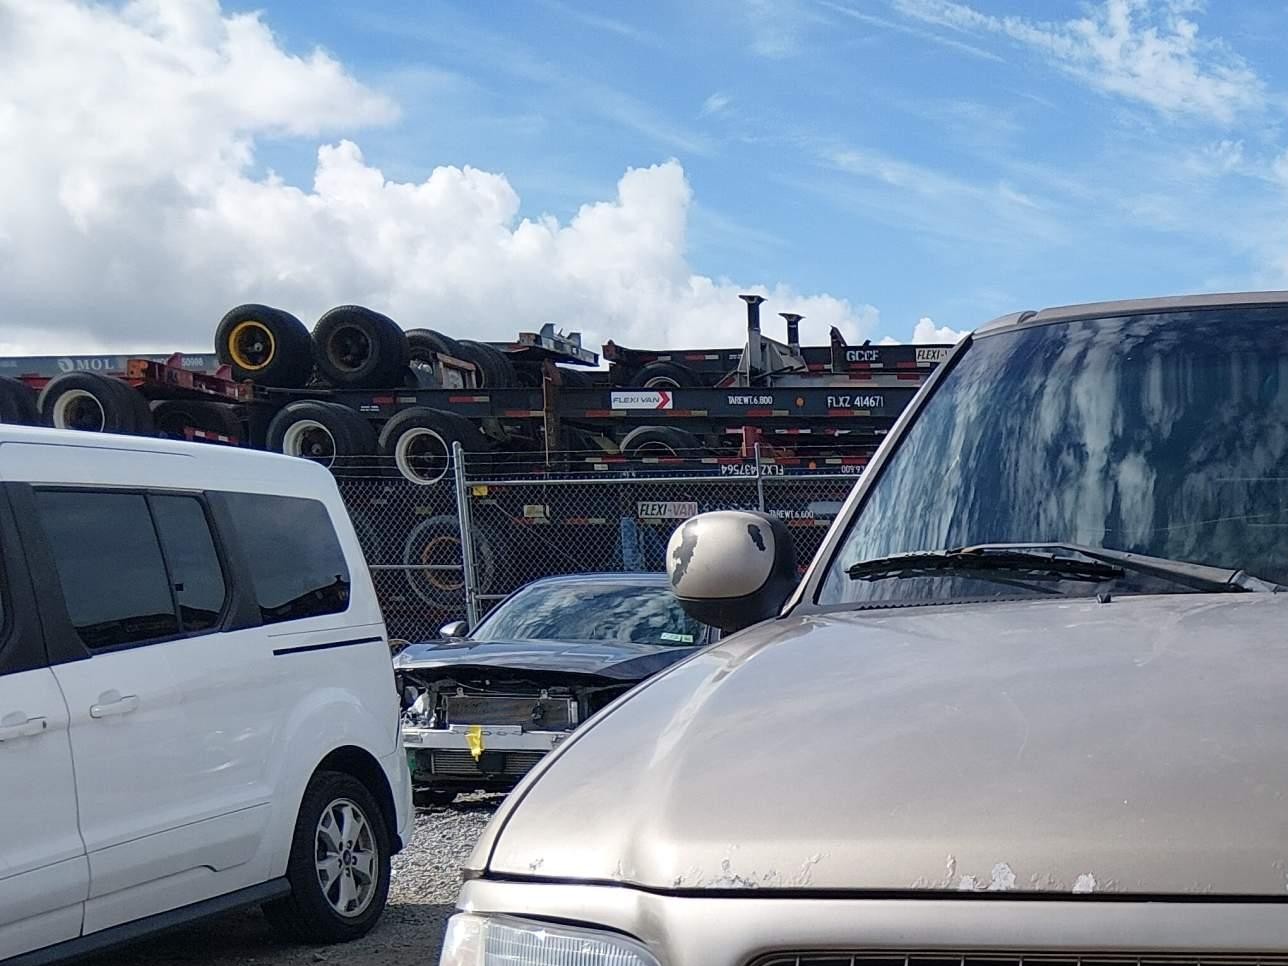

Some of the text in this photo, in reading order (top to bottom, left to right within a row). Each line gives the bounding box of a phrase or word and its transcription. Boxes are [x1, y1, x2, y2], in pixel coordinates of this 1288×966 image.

[77, 358, 113, 371] MOL
[827, 396, 884, 408] FLXZ 414671
